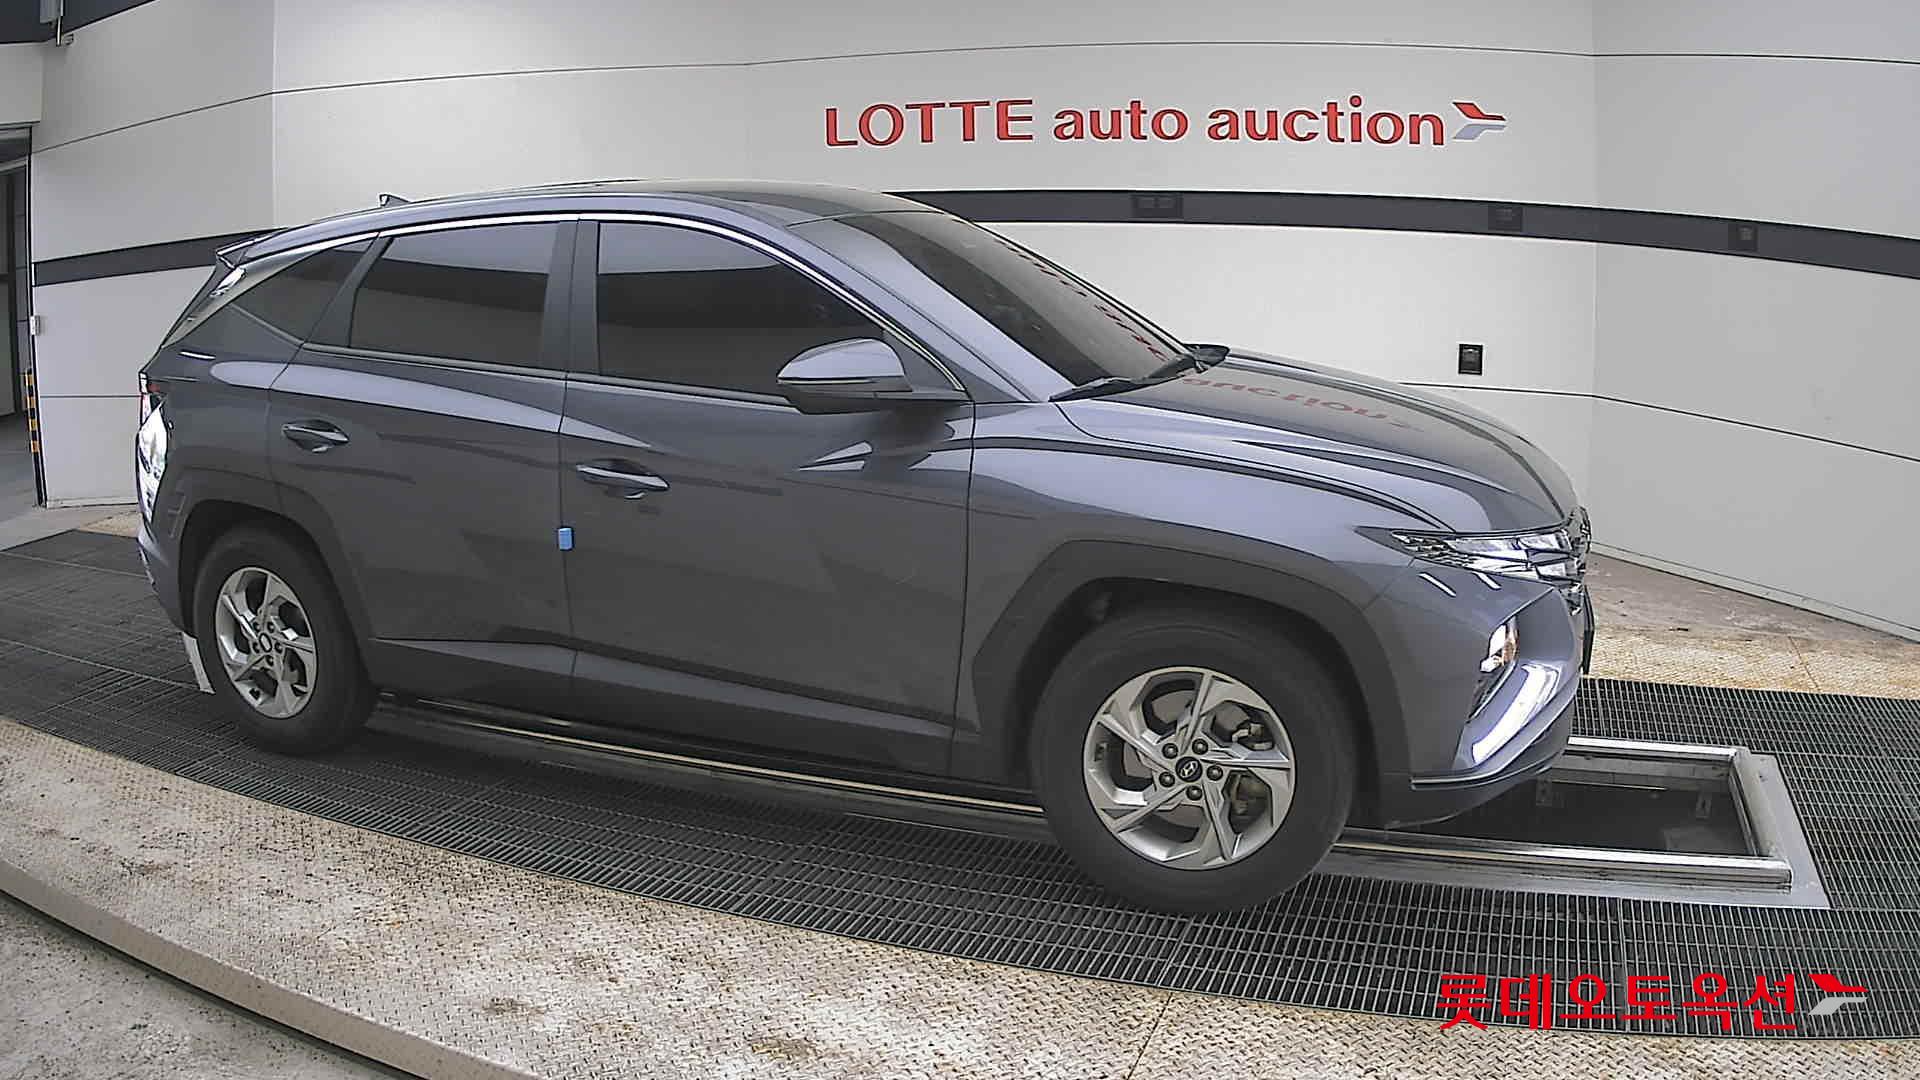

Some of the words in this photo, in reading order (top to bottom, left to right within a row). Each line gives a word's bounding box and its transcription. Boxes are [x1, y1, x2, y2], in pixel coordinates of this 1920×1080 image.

[825, 99, 1033, 147] LOTTE
[1054, 99, 1189, 142] auto
[1207, 95, 1445, 146] auction
